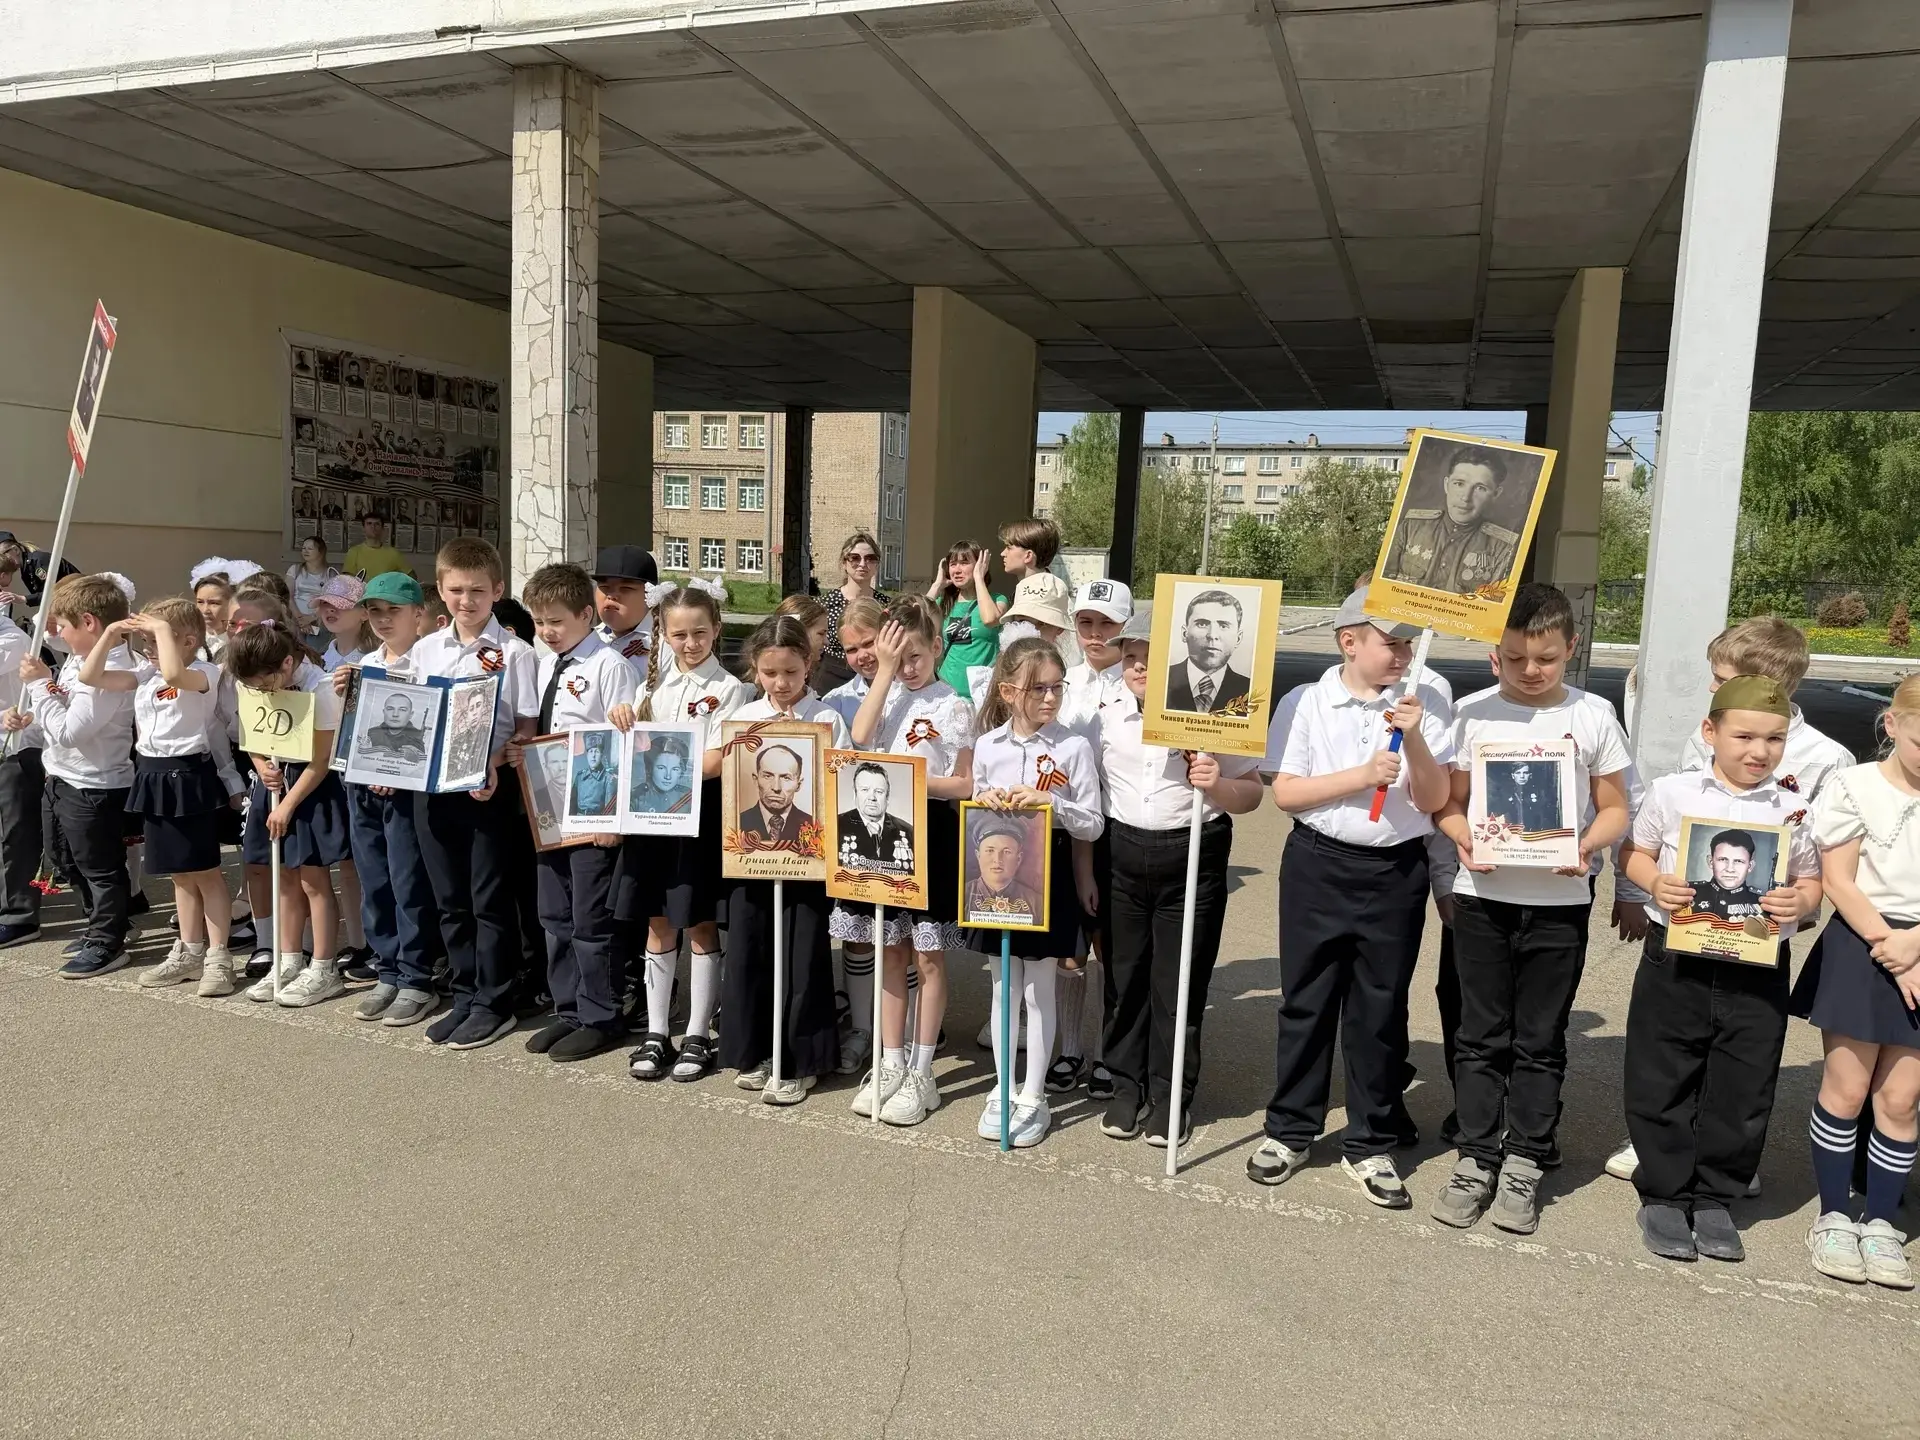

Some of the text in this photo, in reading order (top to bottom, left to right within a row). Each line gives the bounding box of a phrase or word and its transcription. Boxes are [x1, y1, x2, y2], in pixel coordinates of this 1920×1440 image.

[1391, 586, 1488, 612] Поляков Василий Алексеевич
[1404, 600, 1468, 618] старший лейтенант
[1390, 607, 1475, 631] БЕССМЕРТНЫЙ ПОЛК
[1186, 716, 1210, 726] Кузьма
[1212, 719, 1249, 730] Яковлевич
[1164, 734, 1242, 748] БЕССМЕРТНЫЙ ПОЛК
[739, 855, 810, 866] Грицан Иван
[849, 856, 901, 869] Смородинов
[745, 867, 807, 877] Антонович
[867, 866, 909, 877] Иванович
[1704, 927, 1741, 938] ЖДАНОВ
